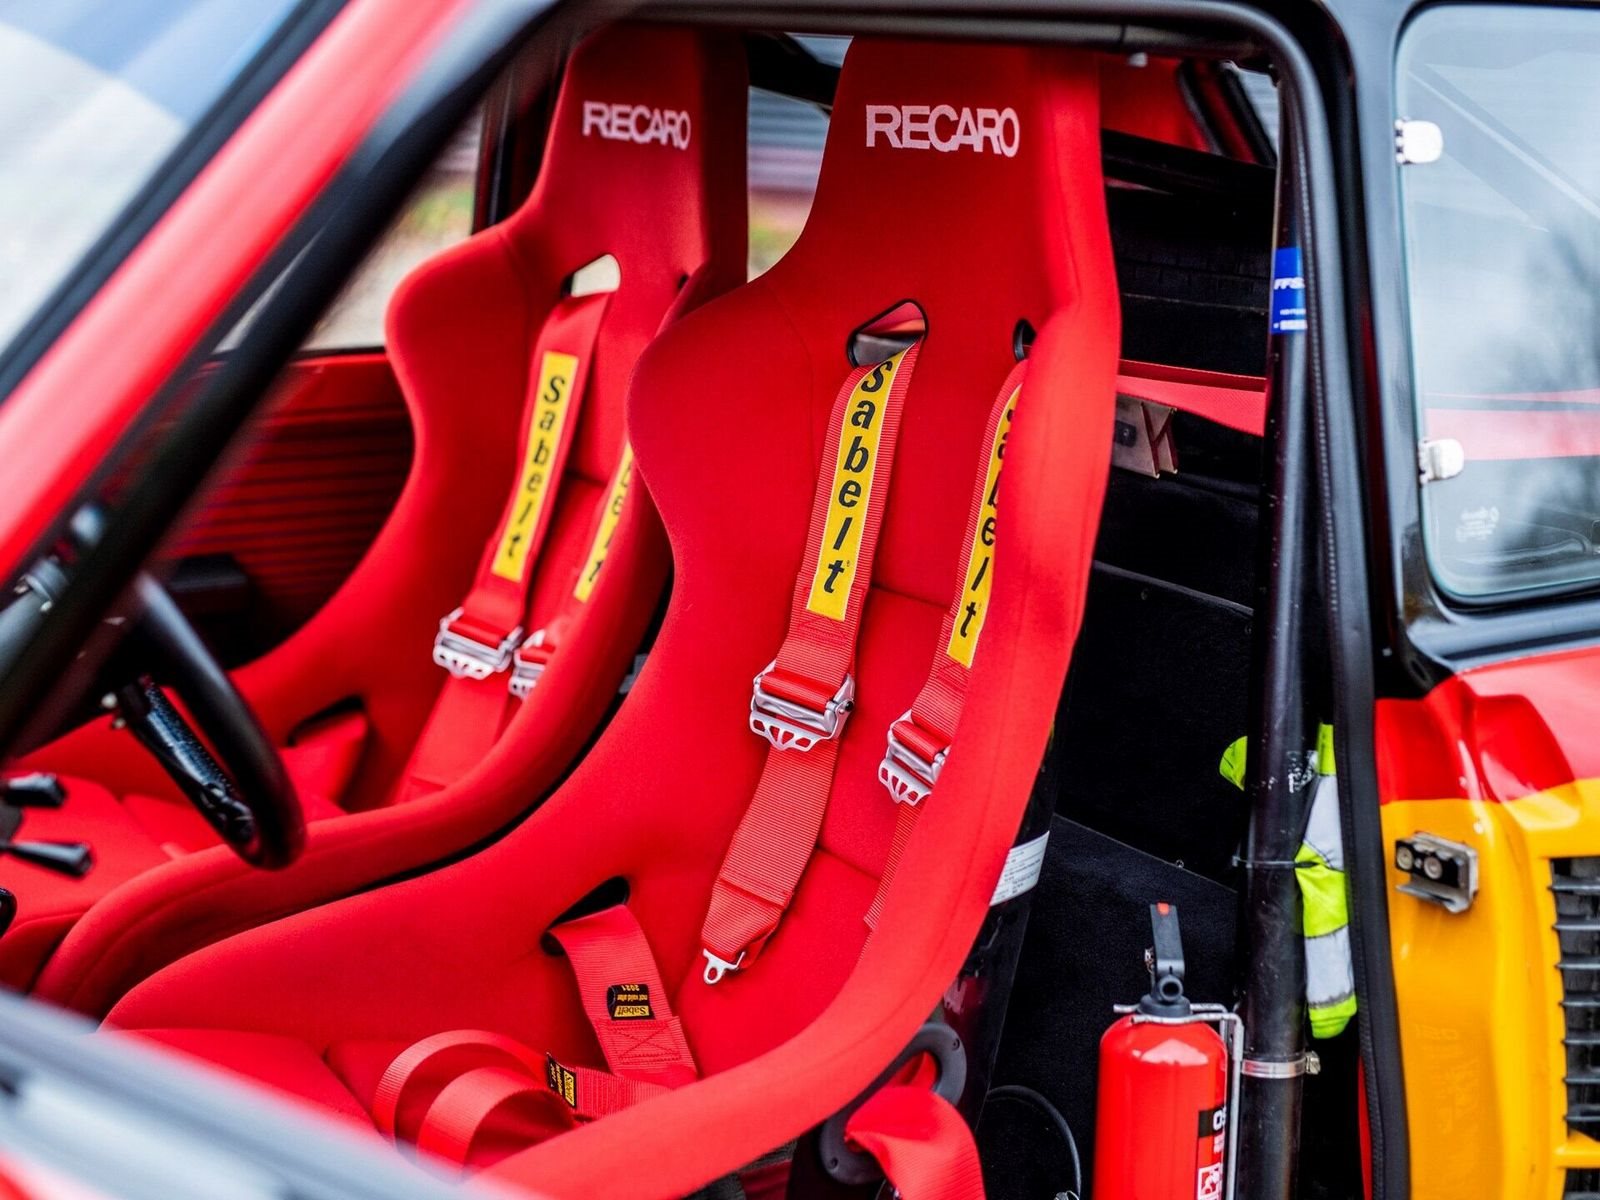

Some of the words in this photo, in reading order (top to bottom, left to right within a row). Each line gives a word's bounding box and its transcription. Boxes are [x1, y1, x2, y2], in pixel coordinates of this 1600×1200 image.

[583, 101, 691, 151] RECARO
[865, 104, 1020, 158] RECARO
[508, 376, 566, 558] Sabelt
[824, 360, 893, 594] Sabelt
[959, 408, 1014, 638] belt
[617, 1006, 646, 1015] Sabelt
